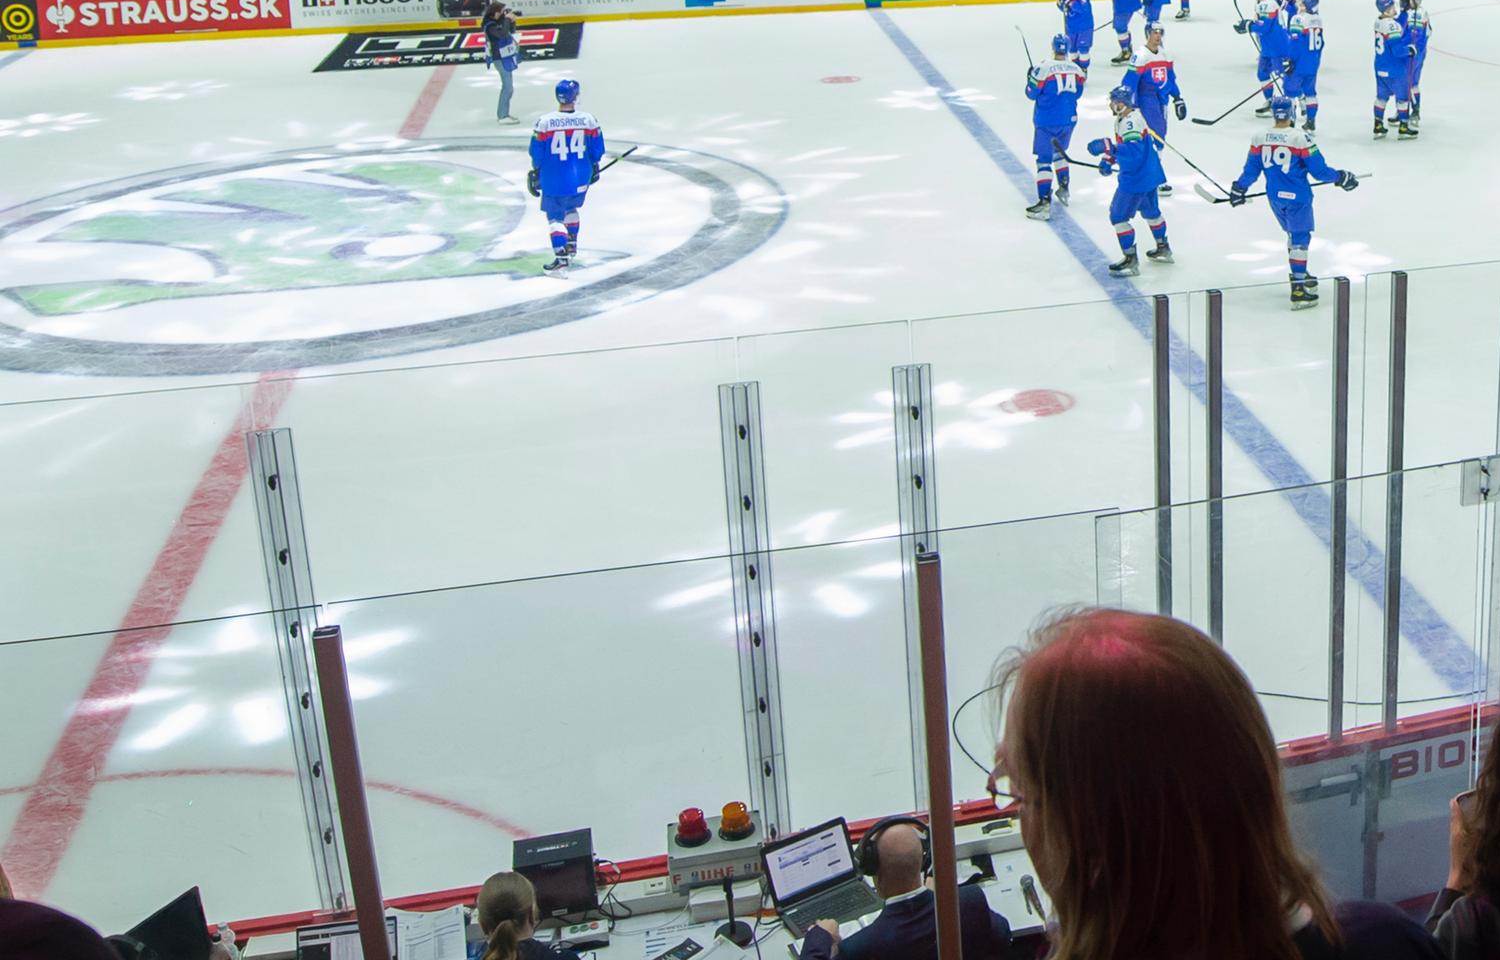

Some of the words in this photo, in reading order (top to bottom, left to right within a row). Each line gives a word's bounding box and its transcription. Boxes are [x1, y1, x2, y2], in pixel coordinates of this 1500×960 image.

[380, 5, 407, 14] SINCE
[1054, 73, 1078, 96] 14
[550, 130, 587, 161] 44
[1261, 145, 1293, 175] 19
[701, 866, 735, 881] IIHF
